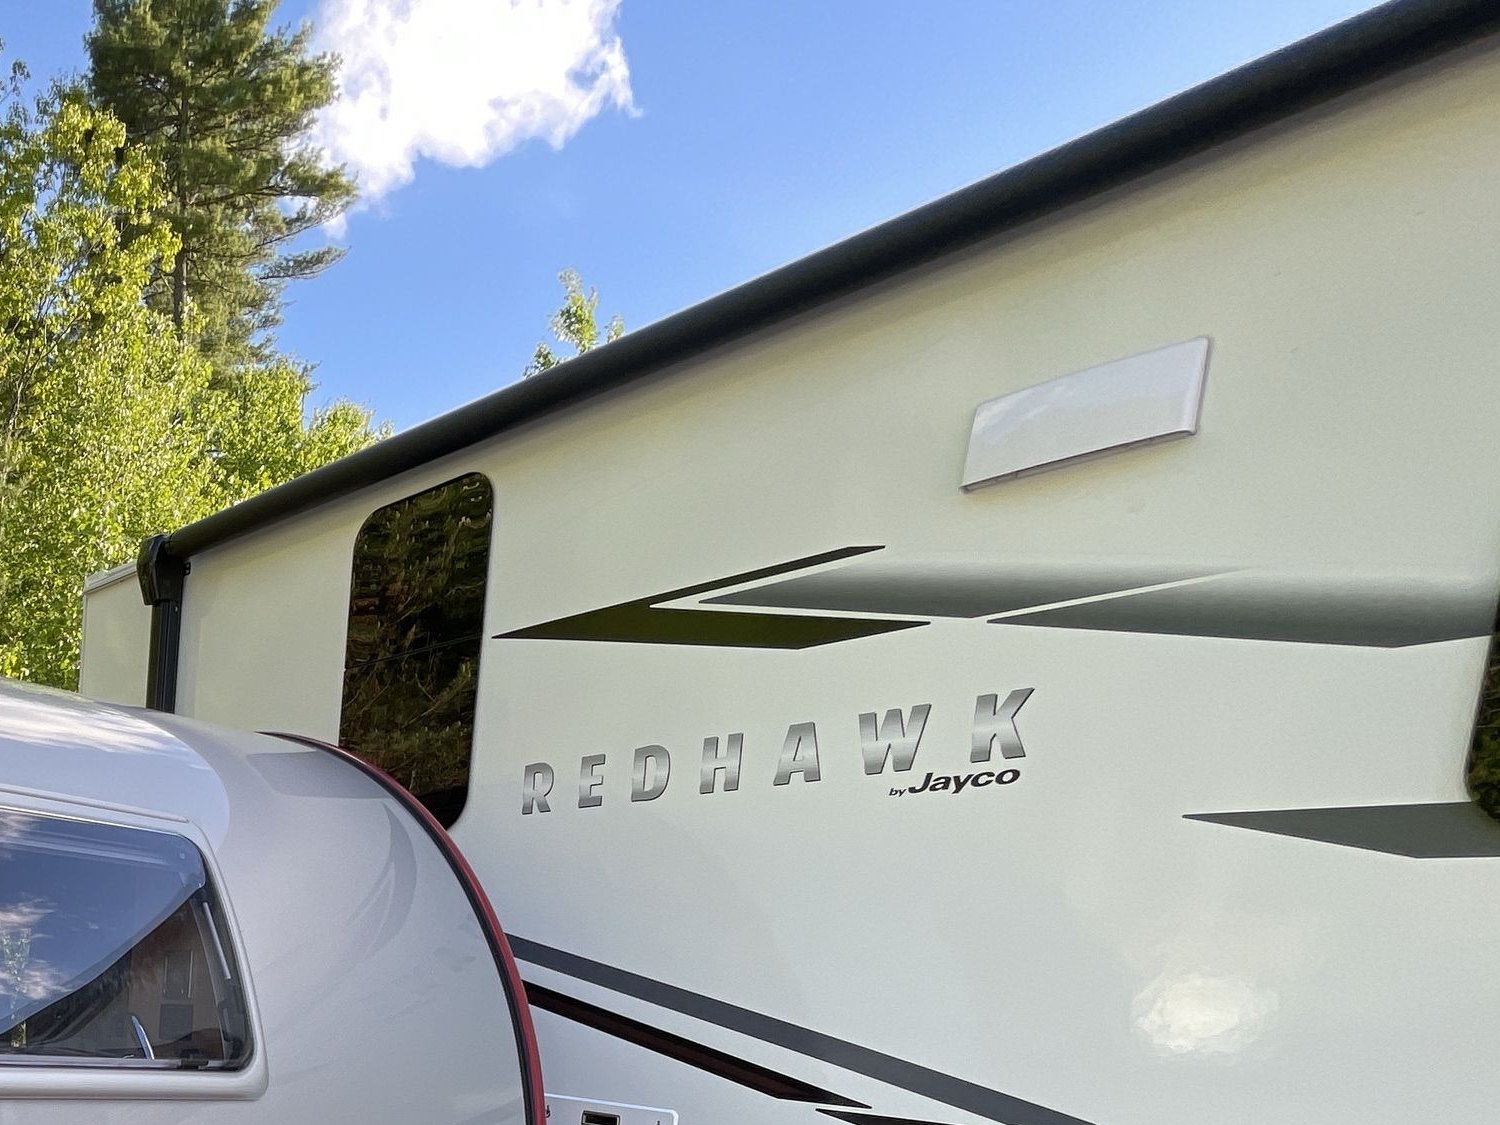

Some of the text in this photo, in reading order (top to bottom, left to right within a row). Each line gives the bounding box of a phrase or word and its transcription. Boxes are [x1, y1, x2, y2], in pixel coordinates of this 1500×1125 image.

[521, 688, 1035, 815] REDHAWK
[888, 769, 1021, 797] by Jayco
